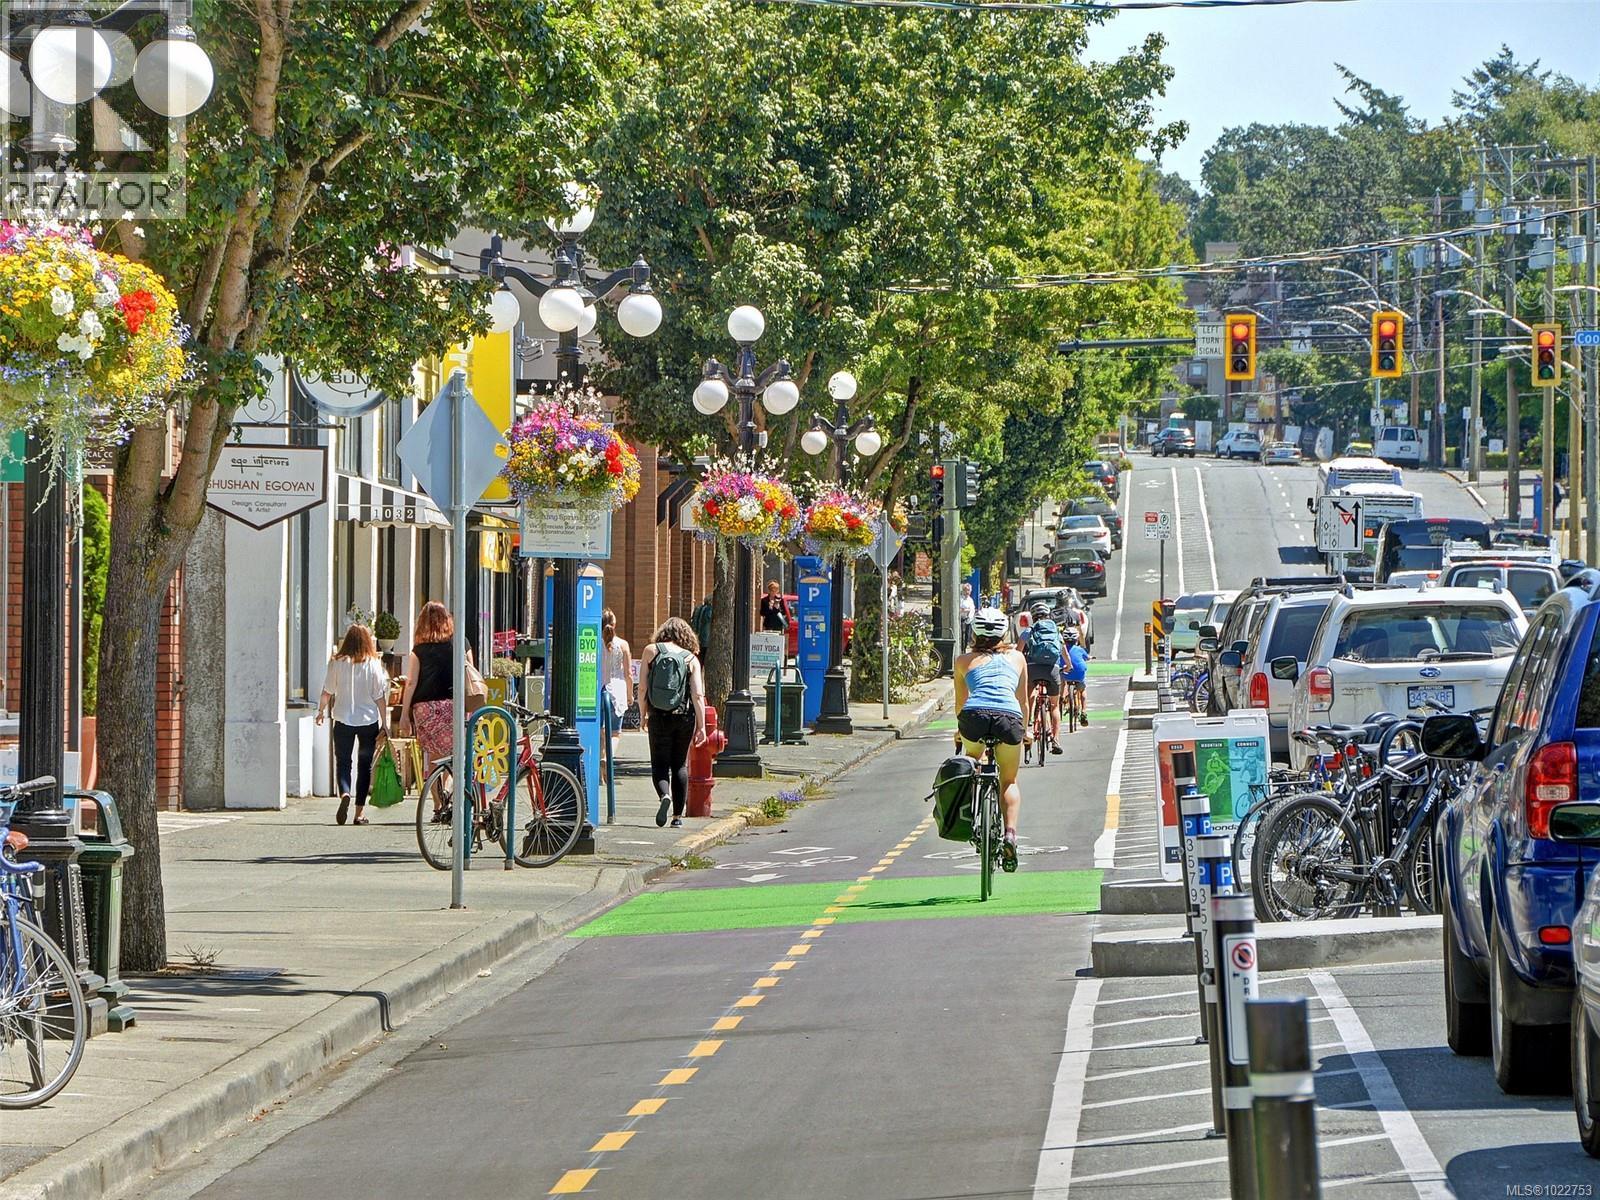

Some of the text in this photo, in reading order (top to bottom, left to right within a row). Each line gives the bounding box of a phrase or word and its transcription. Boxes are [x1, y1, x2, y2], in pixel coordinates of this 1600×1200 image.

[1202, 326, 1219, 334] LEFT
[1199, 347, 1222, 355] SIGNAL
[265, 481, 315, 492] EGOYAN
[374, 508, 415, 519] 1032
[583, 585, 594, 609] P
[808, 587, 820, 602] P
[579, 638, 596, 650] BYO
[751, 644, 780, 652] HOT YOGA
[578, 652, 597, 664] BAG
[1409, 691, 1428, 703] 343
[1184, 820, 1193, 833] P
[1203, 820, 1211, 833] P
[1221, 866, 1230, 884] P
